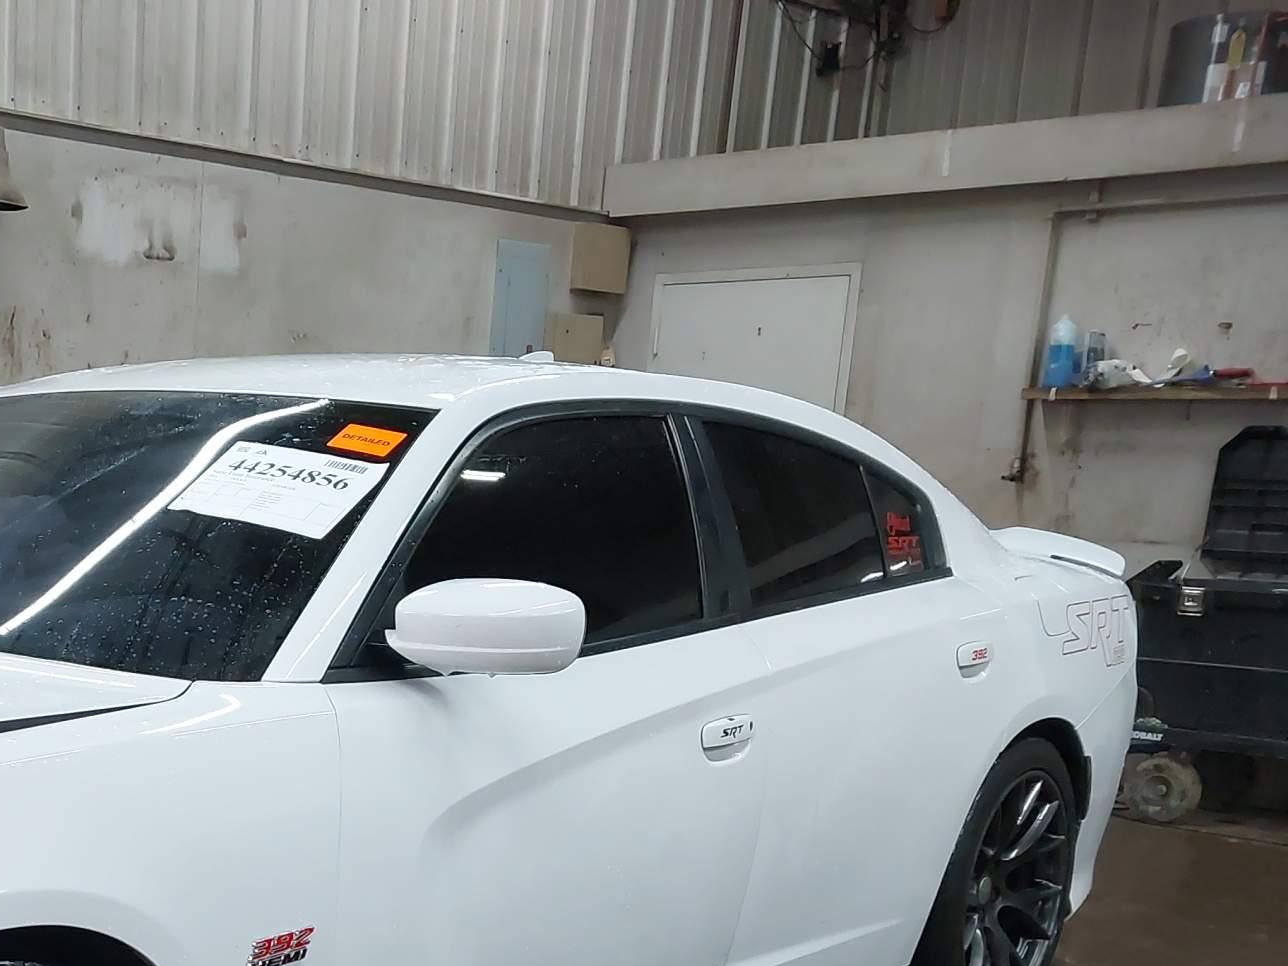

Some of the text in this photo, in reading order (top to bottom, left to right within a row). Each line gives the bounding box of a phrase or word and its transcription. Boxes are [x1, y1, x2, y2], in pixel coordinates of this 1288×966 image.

[342, 433, 391, 447] DETAILED
[229, 458, 351, 491] 44254856
[887, 536, 920, 554] SRT
[1062, 594, 1129, 667] SRT
[971, 647, 988, 661] 392
[720, 724, 744, 739] SRT
[250, 926, 315, 961] 392
